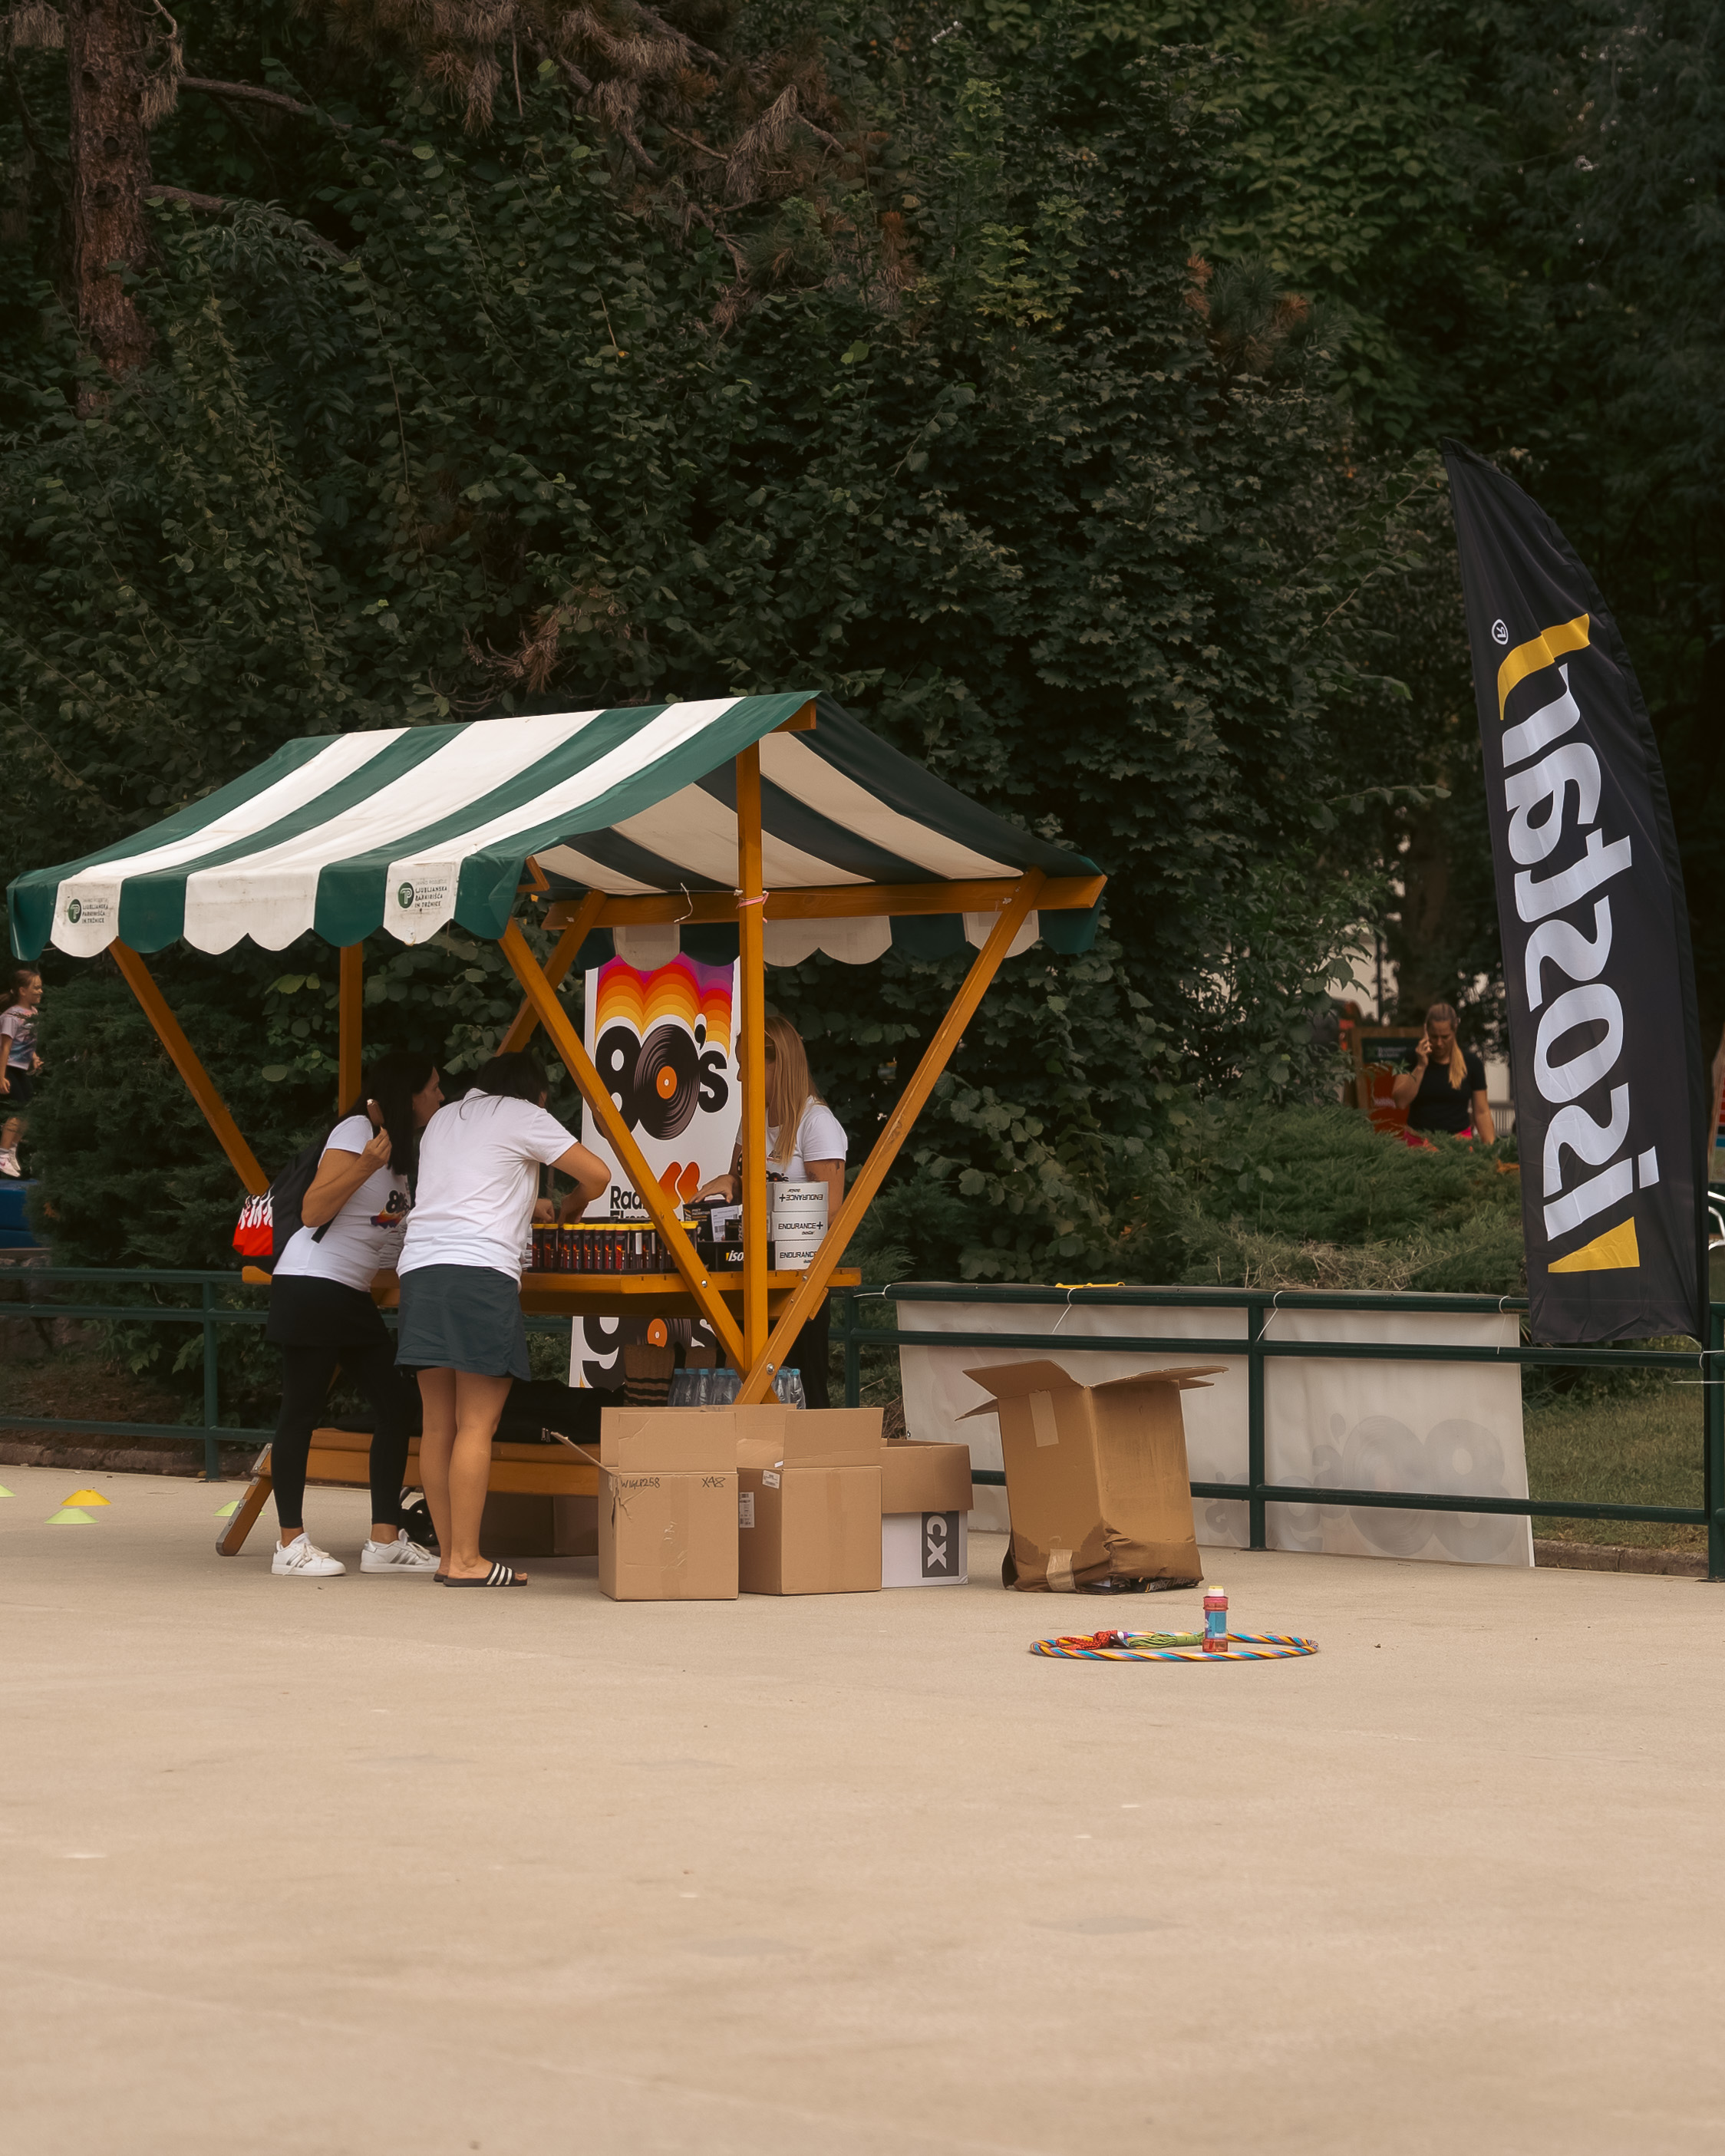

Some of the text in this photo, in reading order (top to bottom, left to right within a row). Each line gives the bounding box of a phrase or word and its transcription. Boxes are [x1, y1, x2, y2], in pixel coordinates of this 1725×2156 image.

[610, 1185, 646, 1209] Rad
[778, 1221, 823, 1230] ENDURANCE+
[728, 1250, 744, 1261] iso
[926, 1512, 947, 1569] CX
